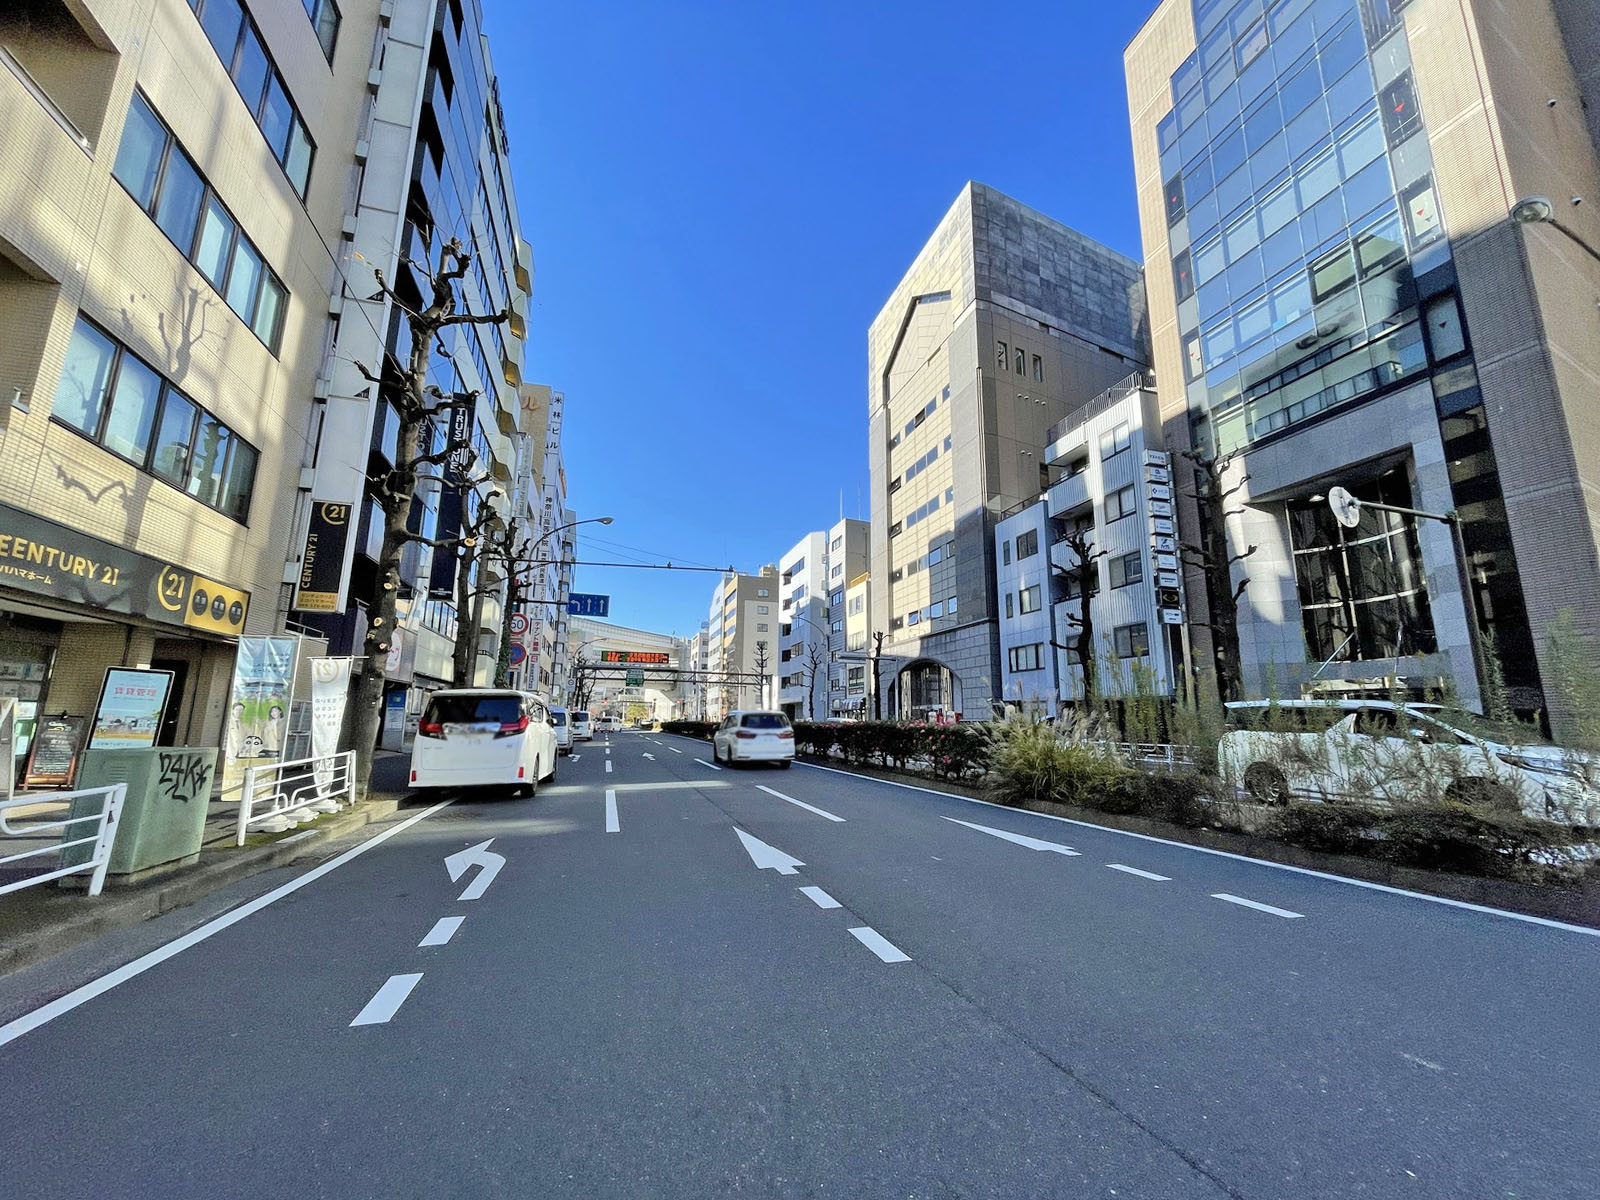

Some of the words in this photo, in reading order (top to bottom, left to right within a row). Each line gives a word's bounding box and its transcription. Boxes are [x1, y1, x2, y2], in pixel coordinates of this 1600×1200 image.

[101, 566, 120, 586] 21
[301, 544, 317, 589] CENTURY
[309, 533, 319, 542] 21
